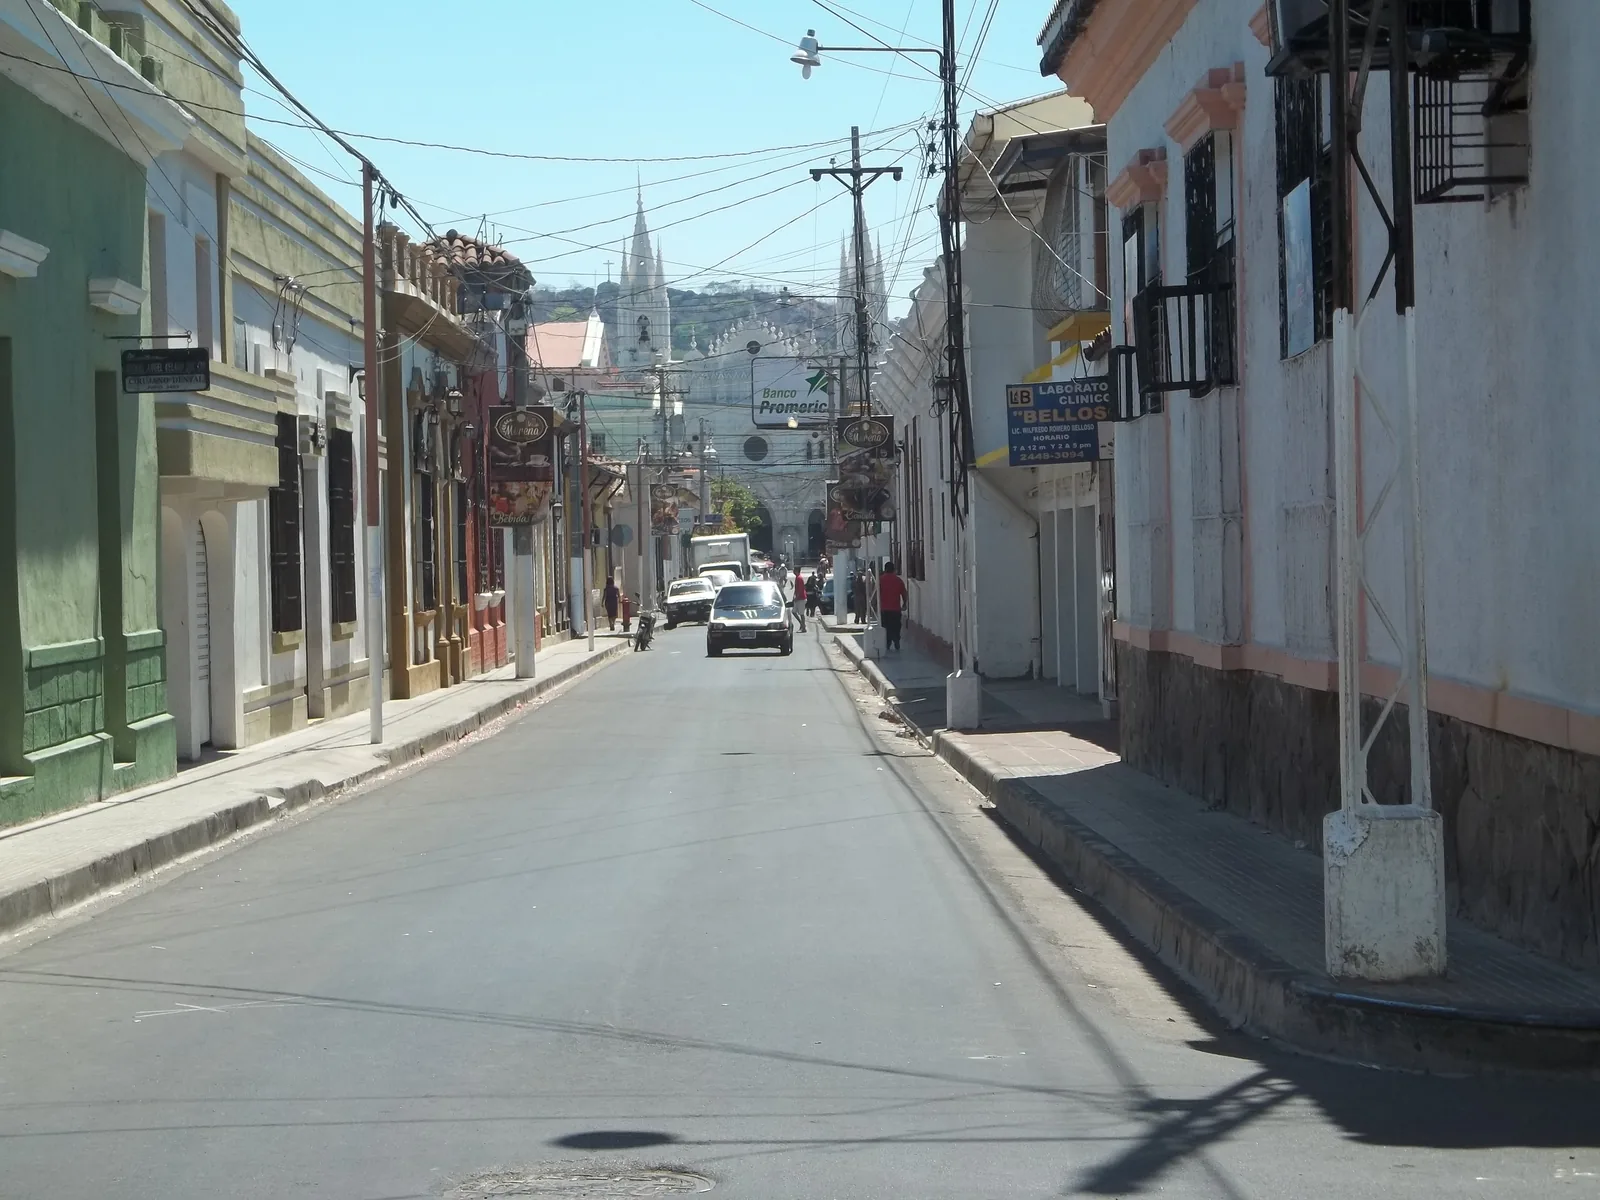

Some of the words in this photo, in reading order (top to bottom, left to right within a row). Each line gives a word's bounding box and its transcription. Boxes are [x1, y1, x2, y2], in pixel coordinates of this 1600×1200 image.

[762, 387, 797, 399] Banco
[1039, 382, 1108, 395] LABORATO
[759, 399, 828, 414] Promeric
[1049, 425, 1071, 433] ROMERO
[853, 431, 882, 442] Mrena
[1033, 434, 1070, 442] HORARIO
